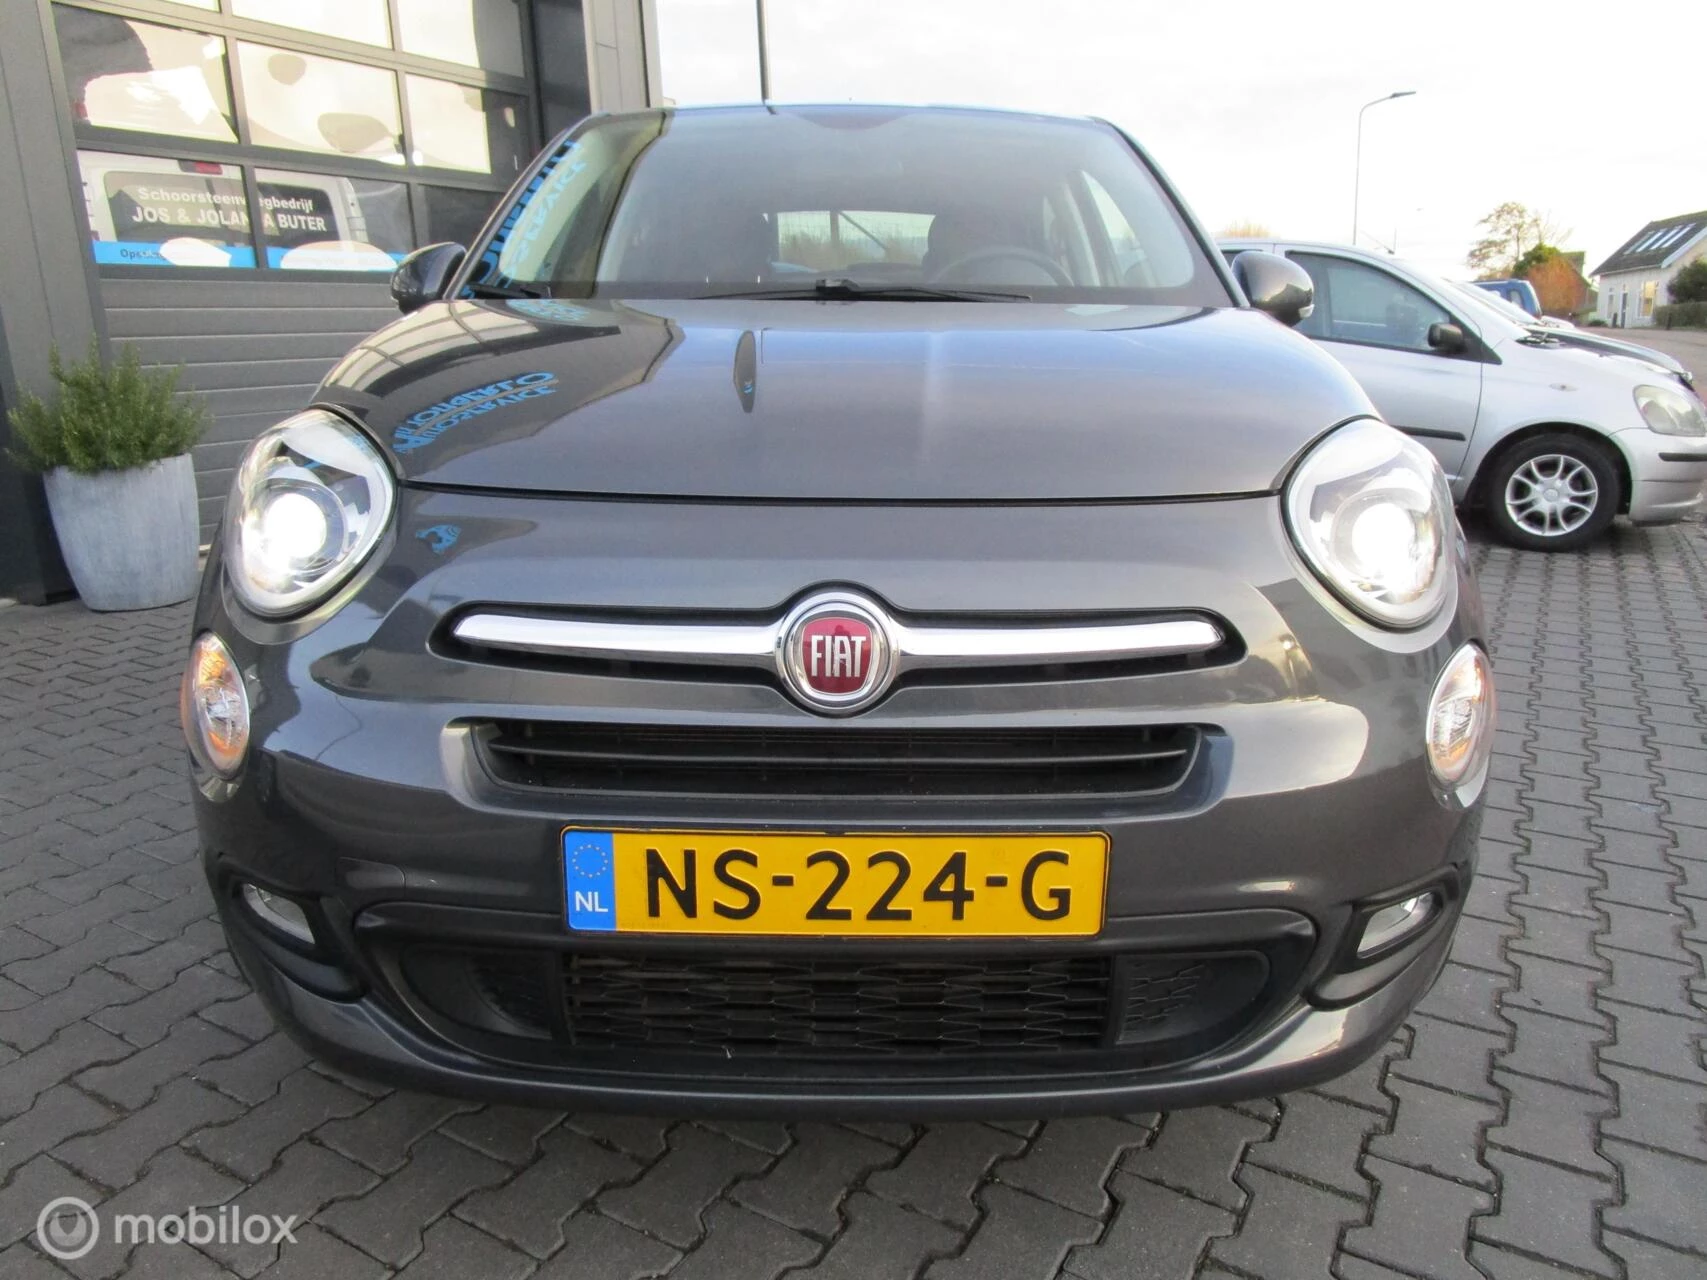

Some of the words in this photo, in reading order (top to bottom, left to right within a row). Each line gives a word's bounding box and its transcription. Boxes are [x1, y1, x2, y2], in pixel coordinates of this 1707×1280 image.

[138, 187, 313, 214] Schoorsteenvegbedrijf
[132, 206, 170, 223] JOS
[177, 207, 191, 223] &
[197, 208, 275, 228] JOLANA
[277, 213, 327, 232] BUTER
[811, 634, 867, 678] FIAT
[645, 848, 1072, 922] NS-224-G
[575, 891, 608, 913] NL
